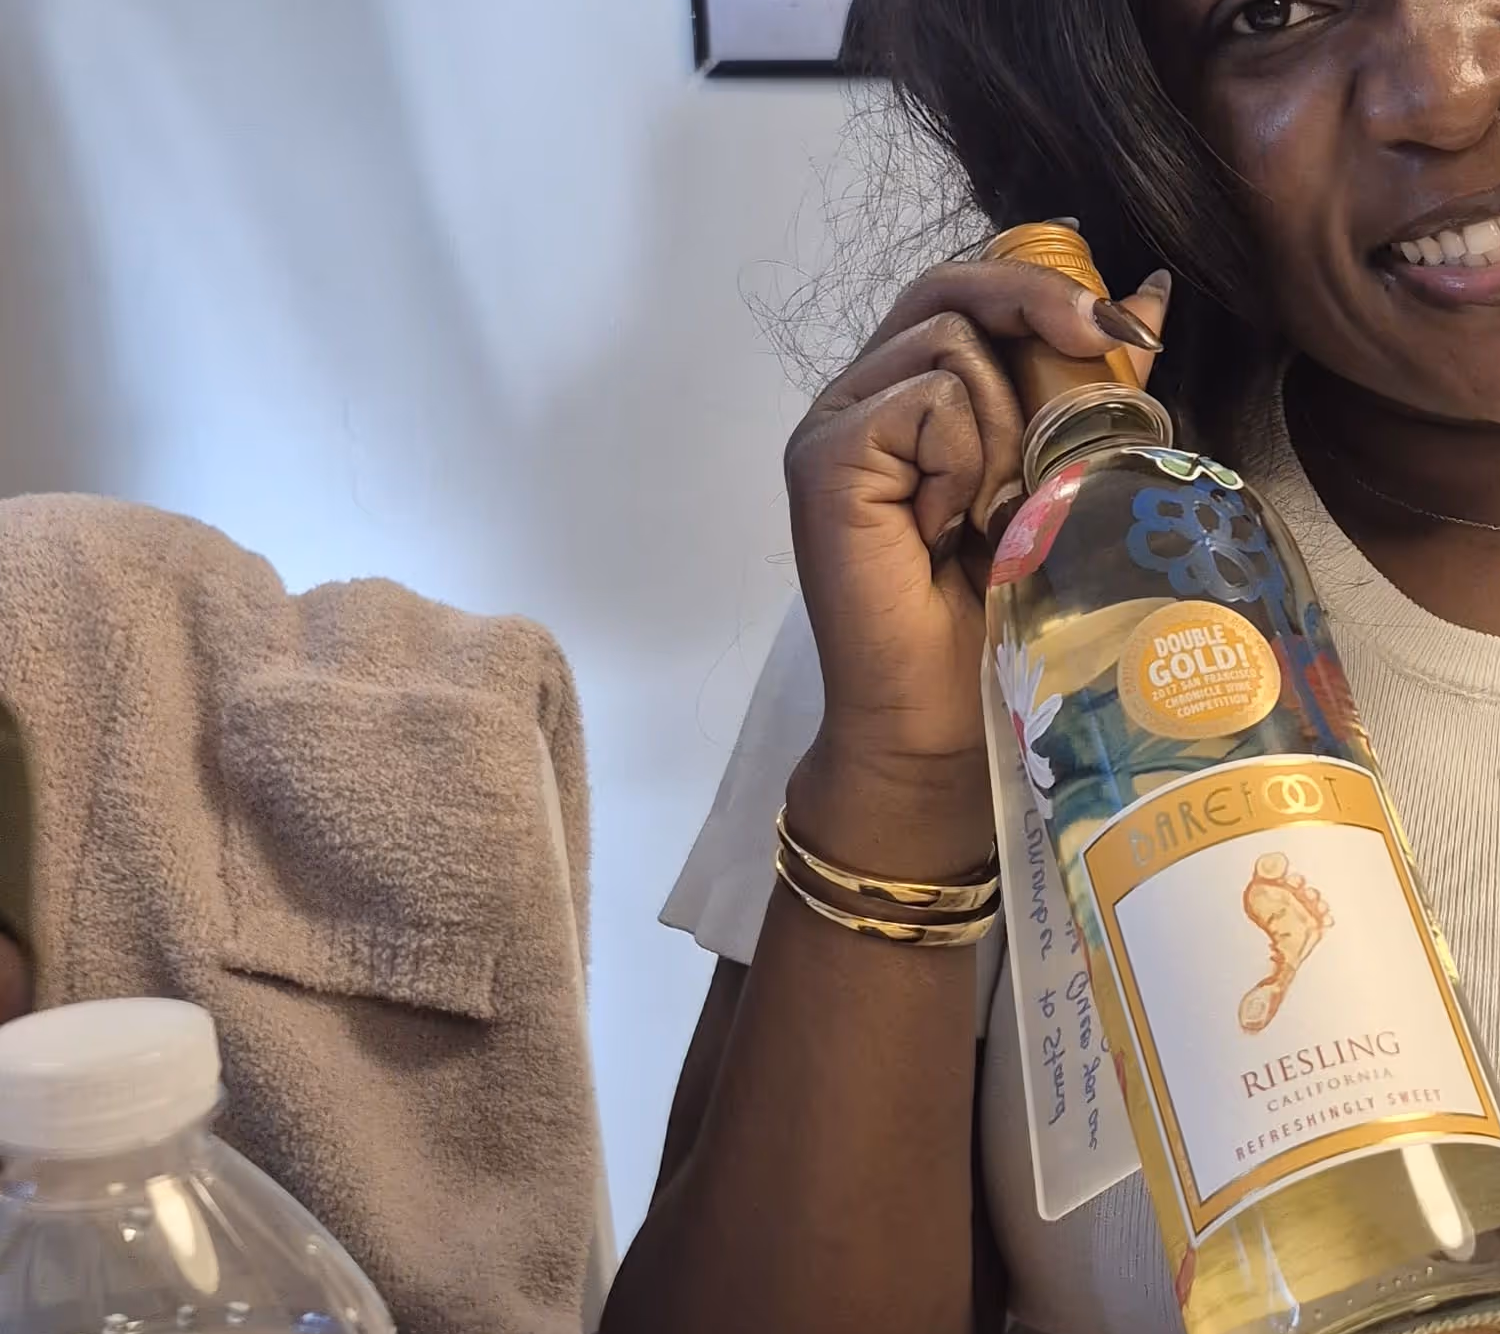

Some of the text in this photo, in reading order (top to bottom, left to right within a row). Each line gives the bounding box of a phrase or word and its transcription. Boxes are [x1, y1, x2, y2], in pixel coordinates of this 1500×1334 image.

[1154, 625, 1227, 657] DOUBLE
[1148, 643, 1250, 688] GOLD!
[1152, 668, 1257, 702] 2017 SAN FRANCISCO
[1165, 682, 1252, 709] CHRONICLE WINE
[1177, 695, 1250, 717] COMPETITION
[1240, 1031, 1401, 1098] RIESLING
[1266, 1068, 1394, 1113] CALIFORNIA
[1234, 1088, 1442, 1162] REFRESHINGLY SWEET
